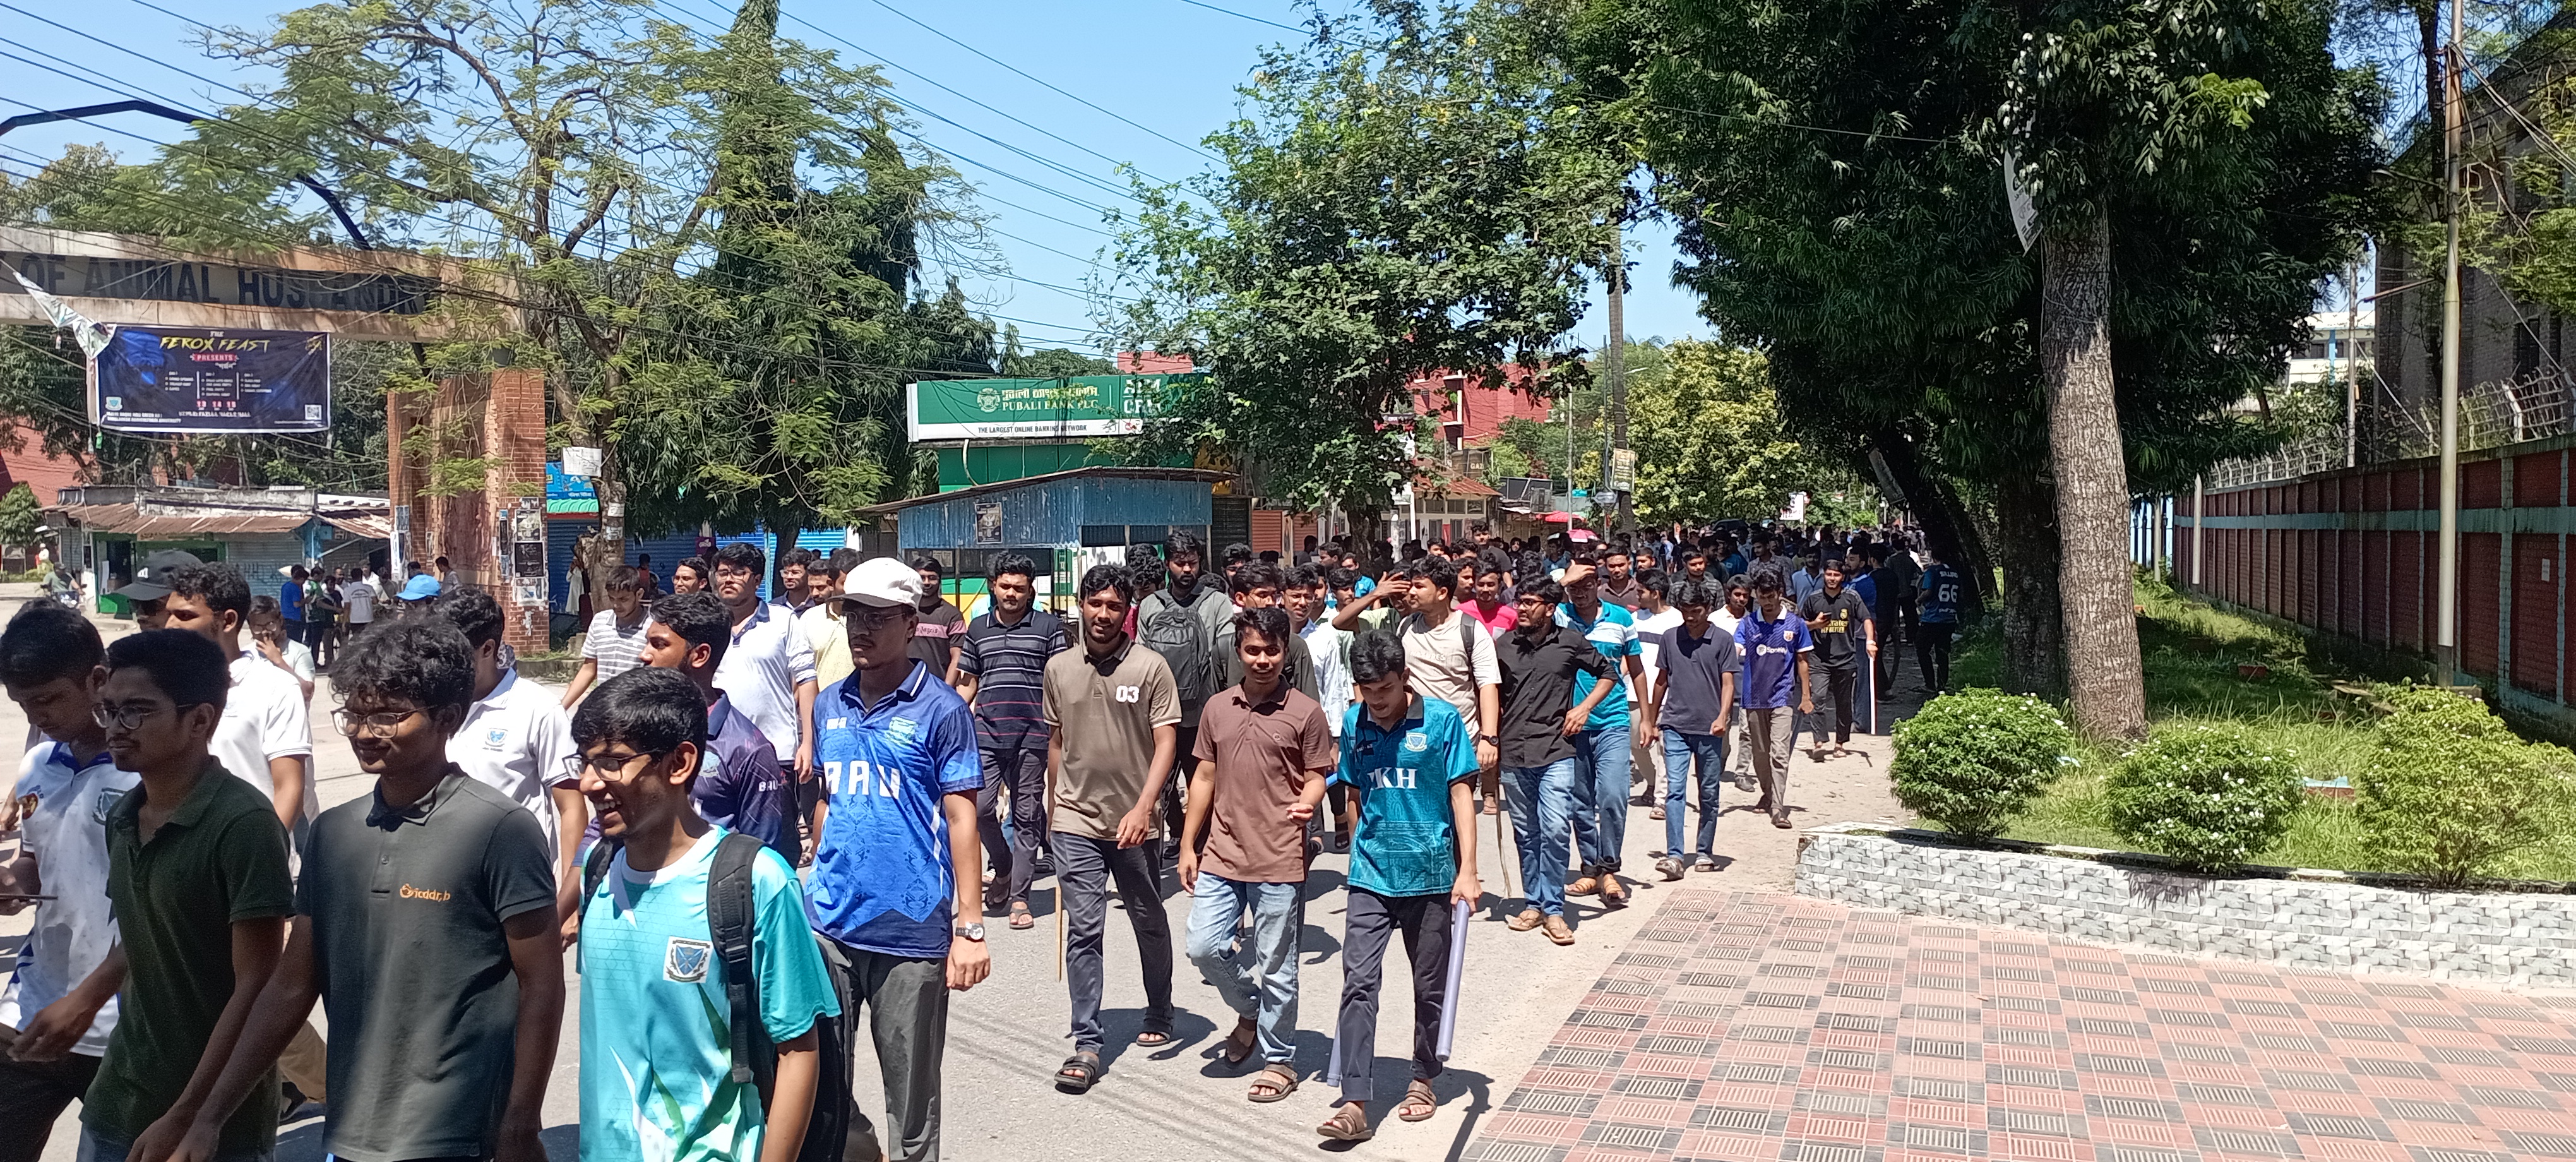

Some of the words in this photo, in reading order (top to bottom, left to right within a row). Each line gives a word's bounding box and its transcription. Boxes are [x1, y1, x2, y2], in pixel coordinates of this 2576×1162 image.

[20, 255, 66, 294] OF
[83, 256, 220, 303] ANIMAL
[159, 337, 215, 353] FEROX
[218, 338, 271, 354] FEAST
[1002, 400, 1042, 411] PUBALI
[1044, 400, 1075, 410] BANK
[1077, 399, 1099, 410] PLC
[1938, 584, 1959, 602] 66
[1116, 685, 1140, 704] 03
[823, 760, 900, 800] BAU
[414, 887, 451, 902] icddr,b
